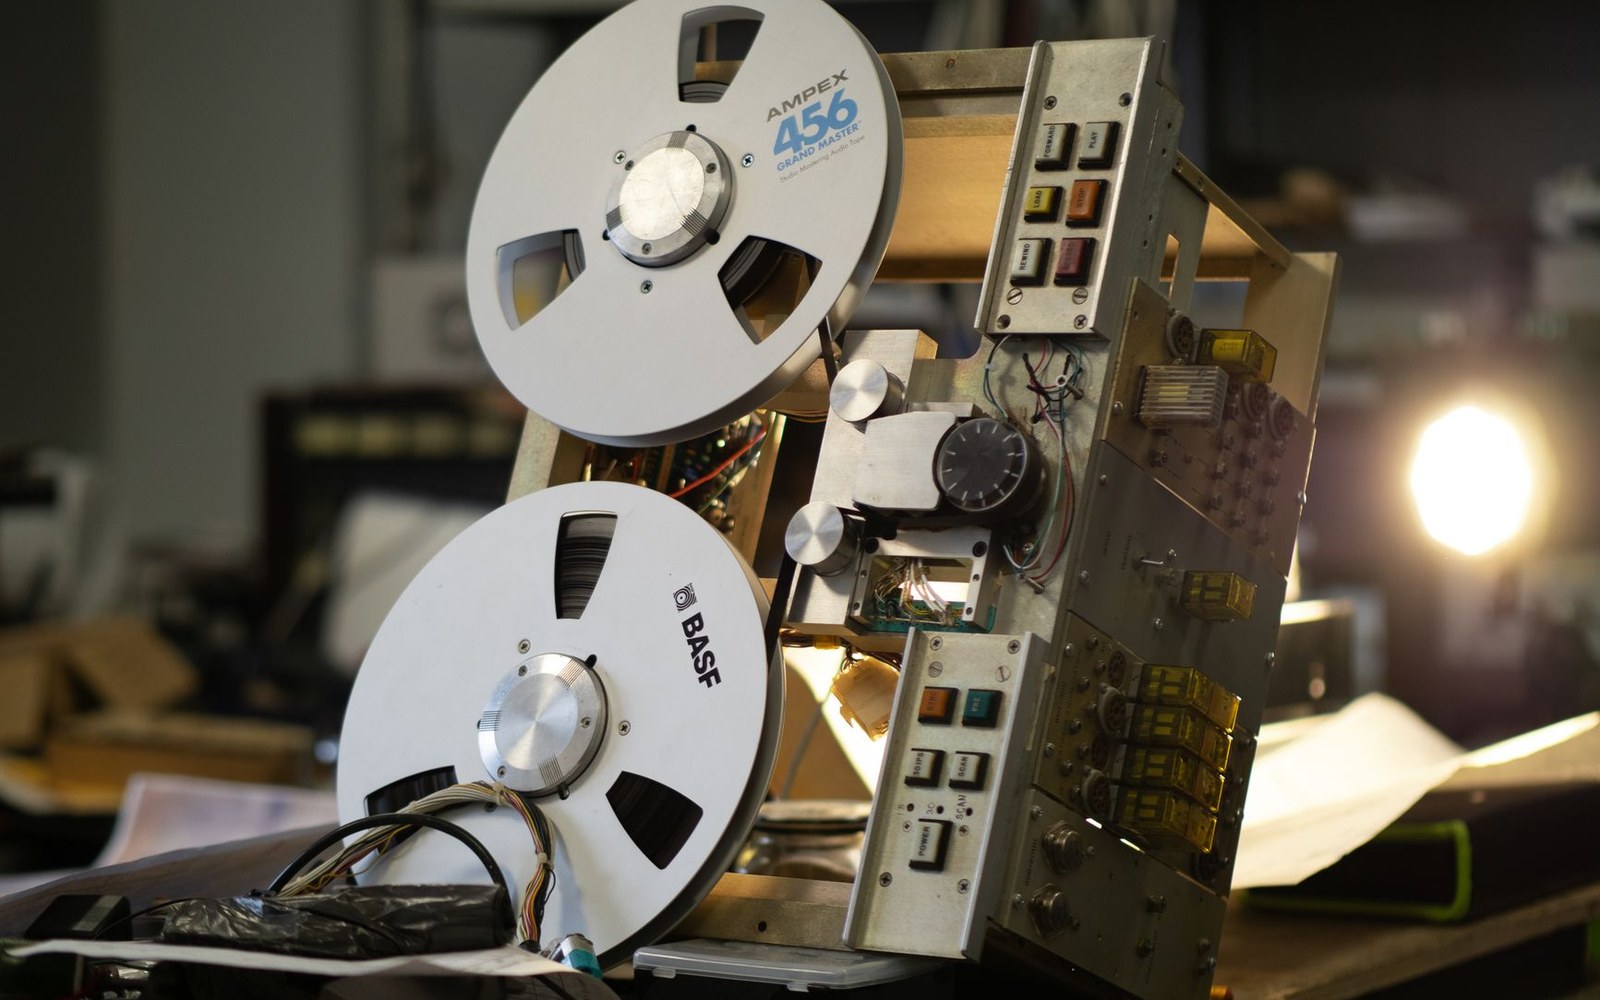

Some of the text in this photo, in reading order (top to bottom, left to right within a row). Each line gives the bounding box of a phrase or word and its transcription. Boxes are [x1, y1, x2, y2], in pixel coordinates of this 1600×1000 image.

[767, 69, 849, 123] AMPEX
[773, 87, 859, 156] 456
[799, 153, 830, 174] Mastering
[830, 143, 850, 158] Audio
[850, 134, 866, 148] Tape
[1043, 125, 1056, 158] FORWARD
[1088, 131, 1099, 149] PLAY
[777, 146, 816, 172] GRAND
[1033, 190, 1043, 208] LOAD
[1019, 243, 1031, 271] REWIND
[681, 611, 722, 689] BASF
[957, 756, 969, 778] SCAN
[955, 794, 968, 820] SCAN
[918, 825, 931, 857] POWER
